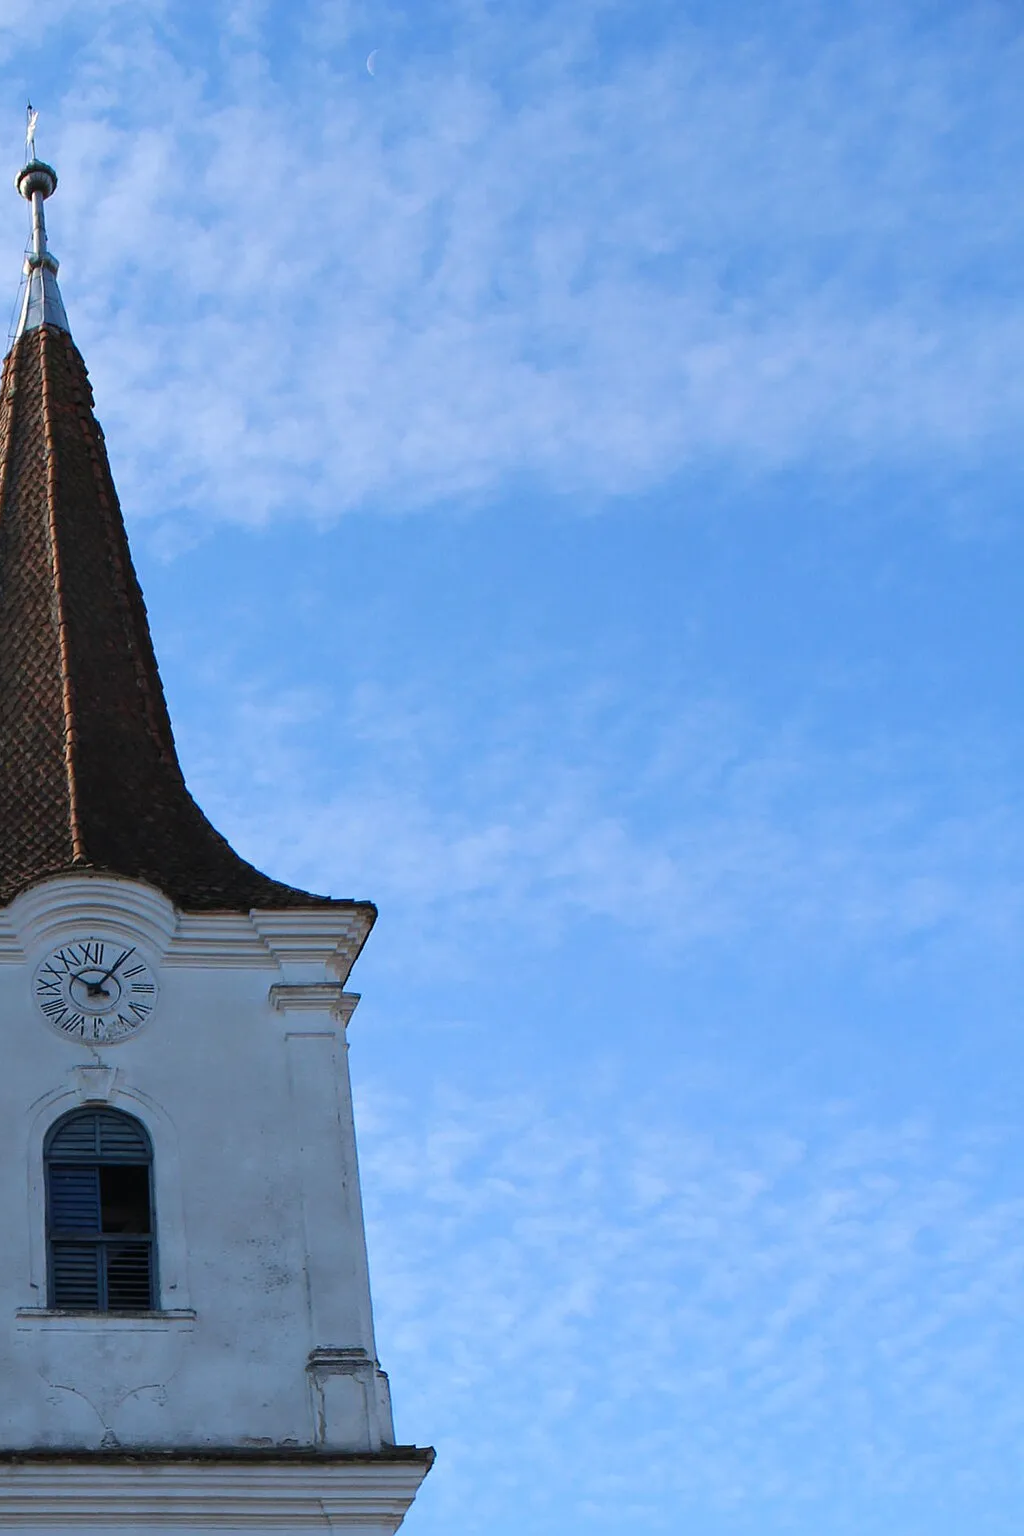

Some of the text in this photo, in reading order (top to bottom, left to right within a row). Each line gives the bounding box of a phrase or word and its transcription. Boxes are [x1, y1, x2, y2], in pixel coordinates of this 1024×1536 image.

[54, 948, 82, 971] XI
[79, 943, 104, 965] XII
[40, 963, 68, 981] X
[122, 964, 147, 979] II
[36, 979, 62, 995] IX
[131, 983, 155, 993] III
